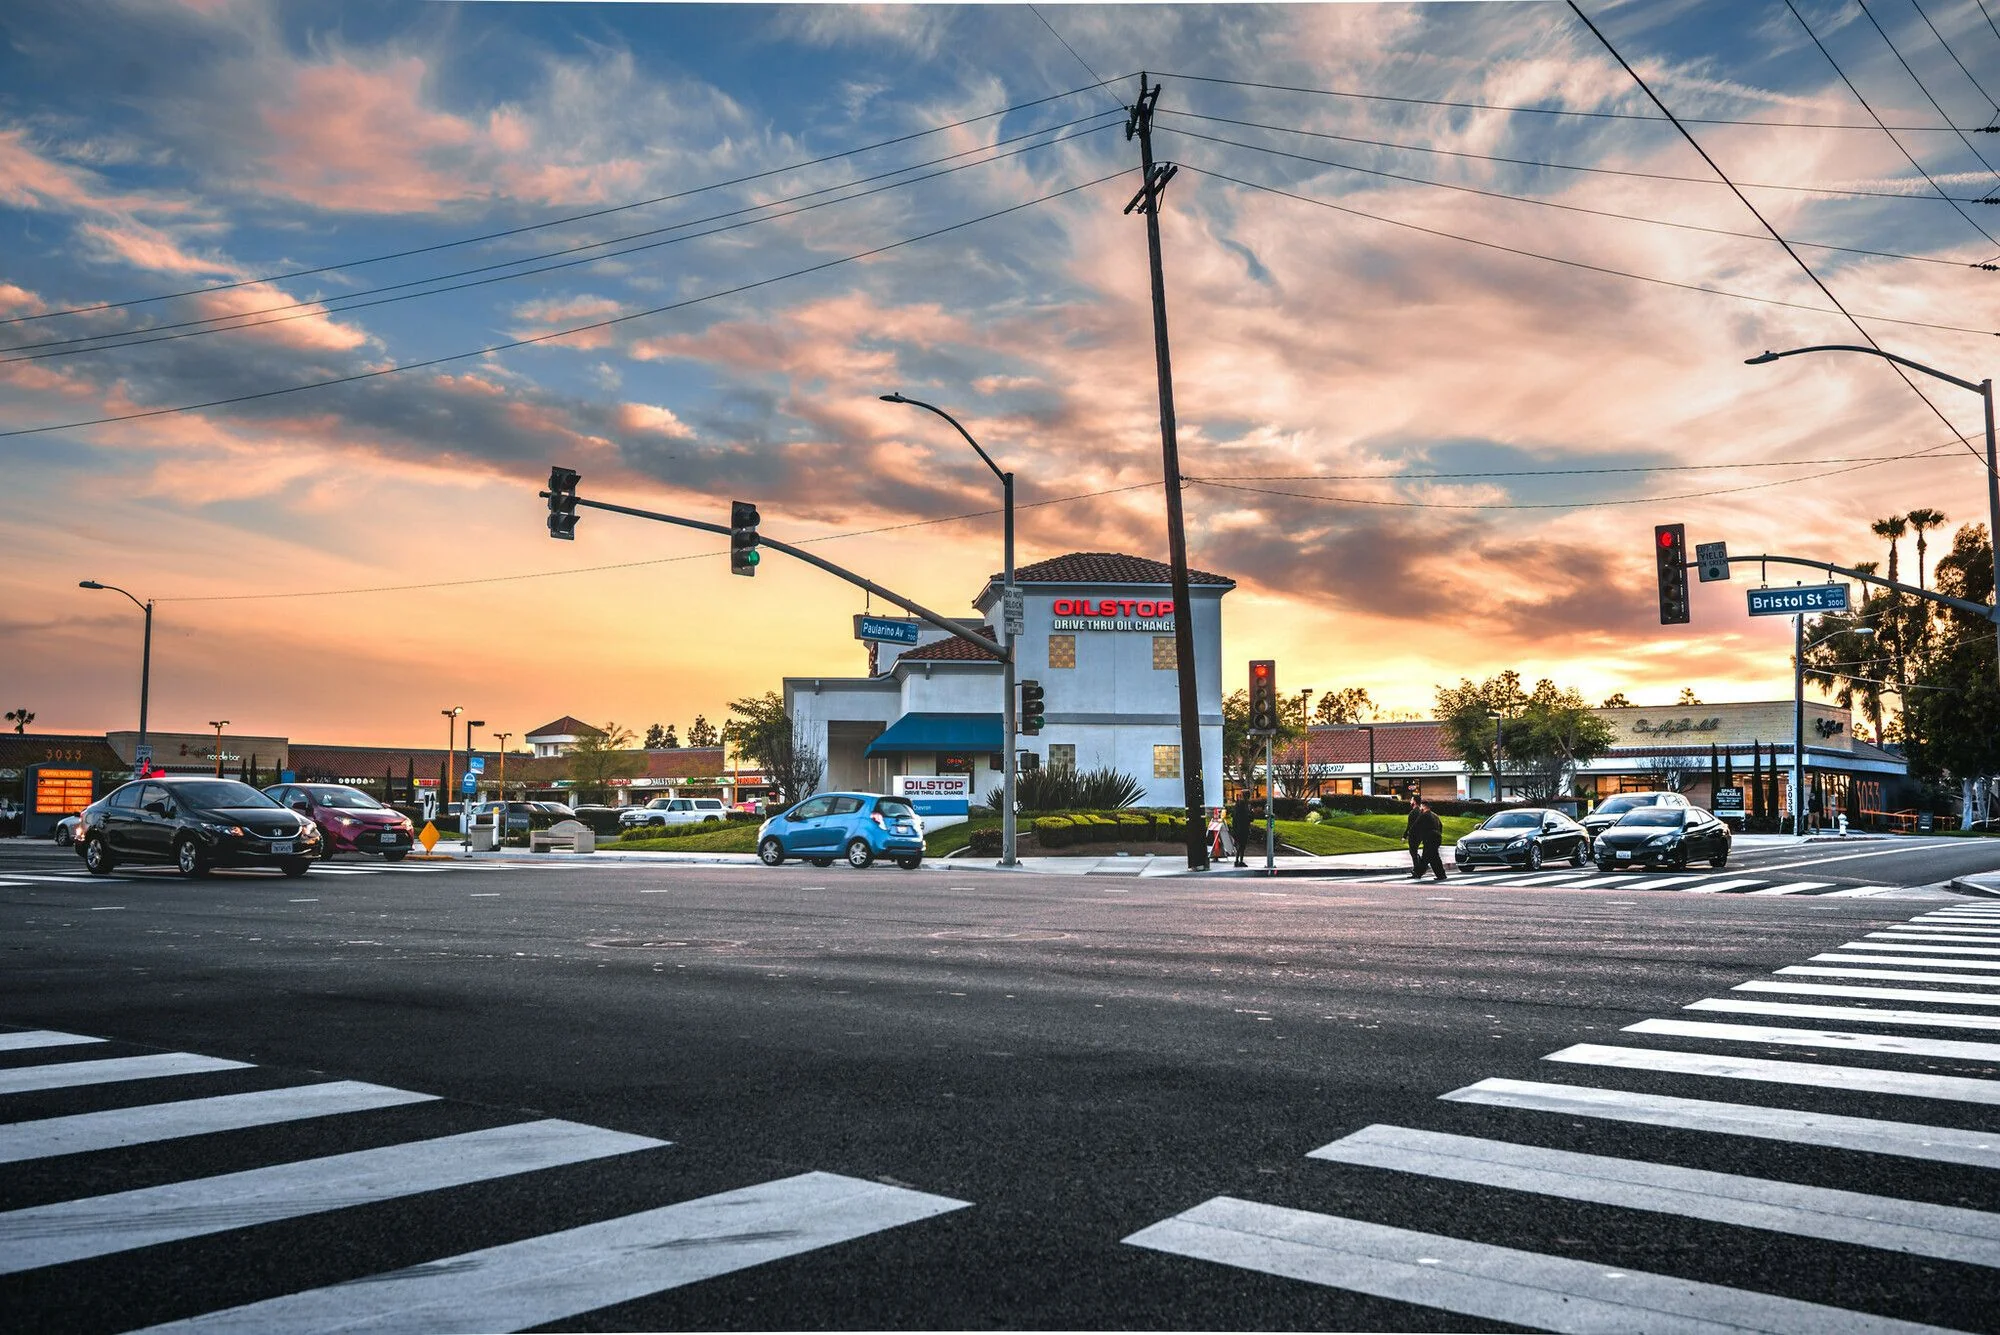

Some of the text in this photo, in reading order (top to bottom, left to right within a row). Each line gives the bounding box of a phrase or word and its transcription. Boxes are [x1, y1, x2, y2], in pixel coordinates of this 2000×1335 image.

[1700, 551, 1725, 560] YIELD
[1753, 595, 1803, 609] Bristol
[1807, 593, 1822, 605] St
[1827, 599, 1844, 607] 3000
[1054, 599, 1174, 617] OILSTOP
[863, 622, 894, 637] Paularino
[895, 626, 905, 638] Av
[1055, 620, 1175, 631] DRIVE THRU OIL CHANGE
[229, 752, 240, 761] bar
[905, 781, 963, 790] OILSTOP
